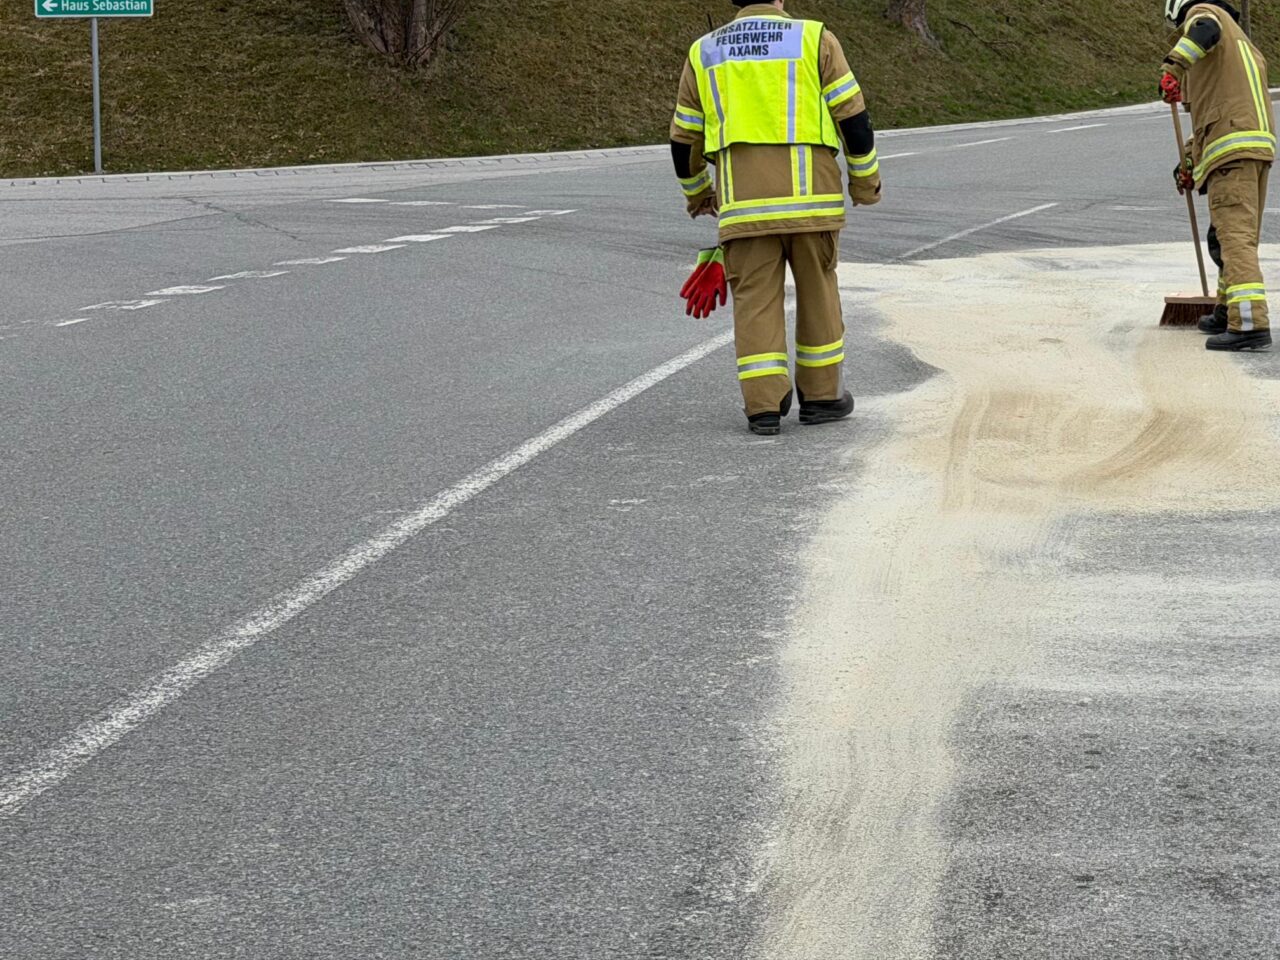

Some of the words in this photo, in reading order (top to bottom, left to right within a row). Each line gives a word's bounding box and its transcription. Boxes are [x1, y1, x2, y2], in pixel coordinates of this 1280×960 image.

[61, 0, 89, 12] Haus
[716, 31, 783, 46] FEUERWEHR
[728, 44, 769, 57] AXAMS
